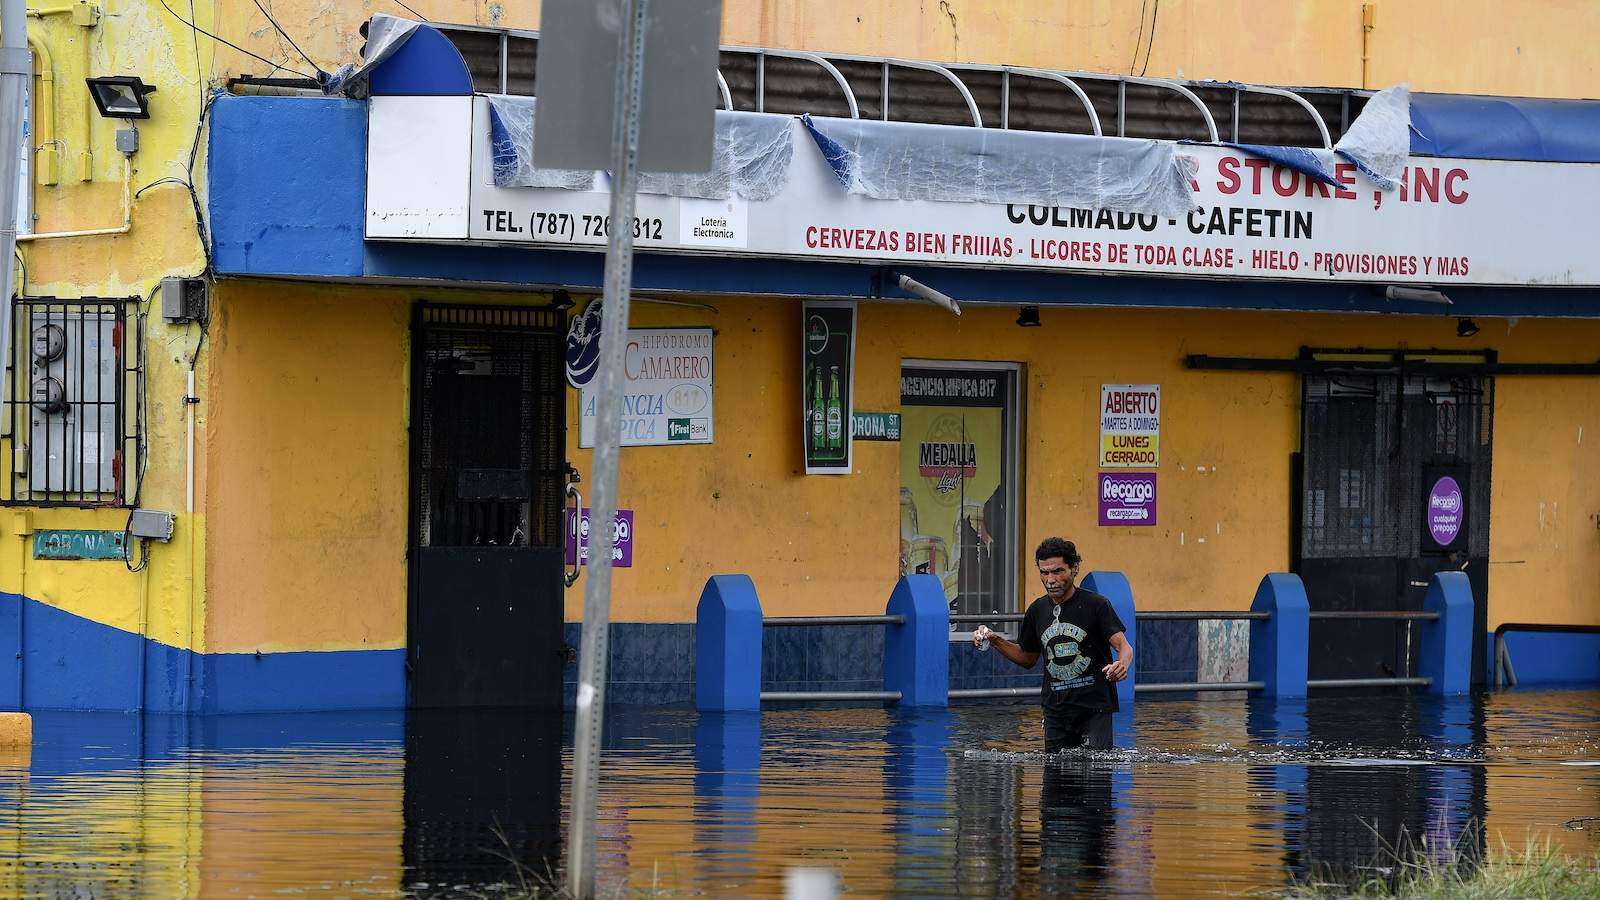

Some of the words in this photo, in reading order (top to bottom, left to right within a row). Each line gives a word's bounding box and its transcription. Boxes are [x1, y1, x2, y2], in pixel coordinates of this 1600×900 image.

[483, 209, 523, 233] TEL.
[530, 211, 576, 241] (787)
[1007, 203, 1158, 232] COLMADO
[1186, 205, 1313, 239] CAFETIN
[805, 226, 899, 252] CERVEZAS
[905, 231, 946, 255] BIEN
[952, 234, 1013, 258] FRIIIAS
[1030, 238, 1101, 263] LICORES
[1108, 242, 1128, 264] DE
[1134, 244, 1177, 266] TODA
[1182, 246, 1234, 269] CLASE
[1251, 249, 1299, 271] HIELO
[1314, 252, 1418, 276] PROVISIONES
[1422, 256, 1432, 276] Y
[1437, 256, 1469, 276] MAS
[624, 342, 710, 381] CAMARERO
[584, 393, 664, 417] ANCIA
[1104, 391, 1157, 415] ABIERTO
[852, 416, 886, 437] ORONA
[889, 414, 898, 425] ST
[1104, 417, 1127, 430] MARTES
[1129, 417, 1133, 430] A
[1134, 417, 1157, 431] DOMINGO
[1112, 435, 1150, 448] LUNES
[920, 442, 977, 467] MEDALLA
[1105, 451, 1155, 463] CERRADO
[1103, 478, 1153, 503] Recarga
[1433, 514, 1457, 524] cualquier
[1433, 524, 1457, 535] prepago
